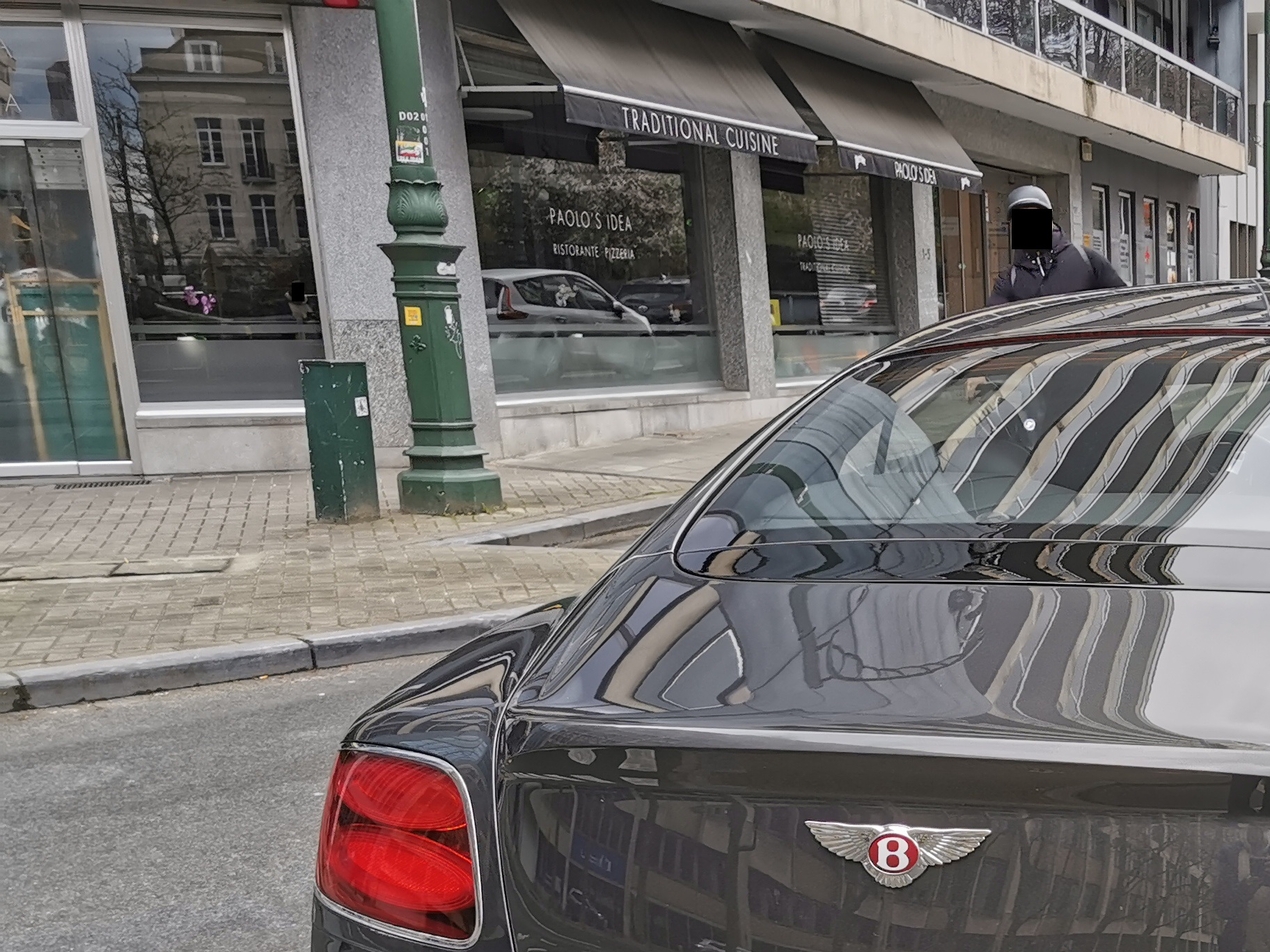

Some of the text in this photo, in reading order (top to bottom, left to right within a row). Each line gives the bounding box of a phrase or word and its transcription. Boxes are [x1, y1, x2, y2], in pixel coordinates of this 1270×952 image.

[622, 106, 779, 156] TRADITIONAL CUISINE
[894, 161, 938, 185] PAOLO'S IDEA
[549, 206, 633, 232] PAOLO'S IDEA
[552, 243, 636, 260] RISTORANTE PIZZERIA
